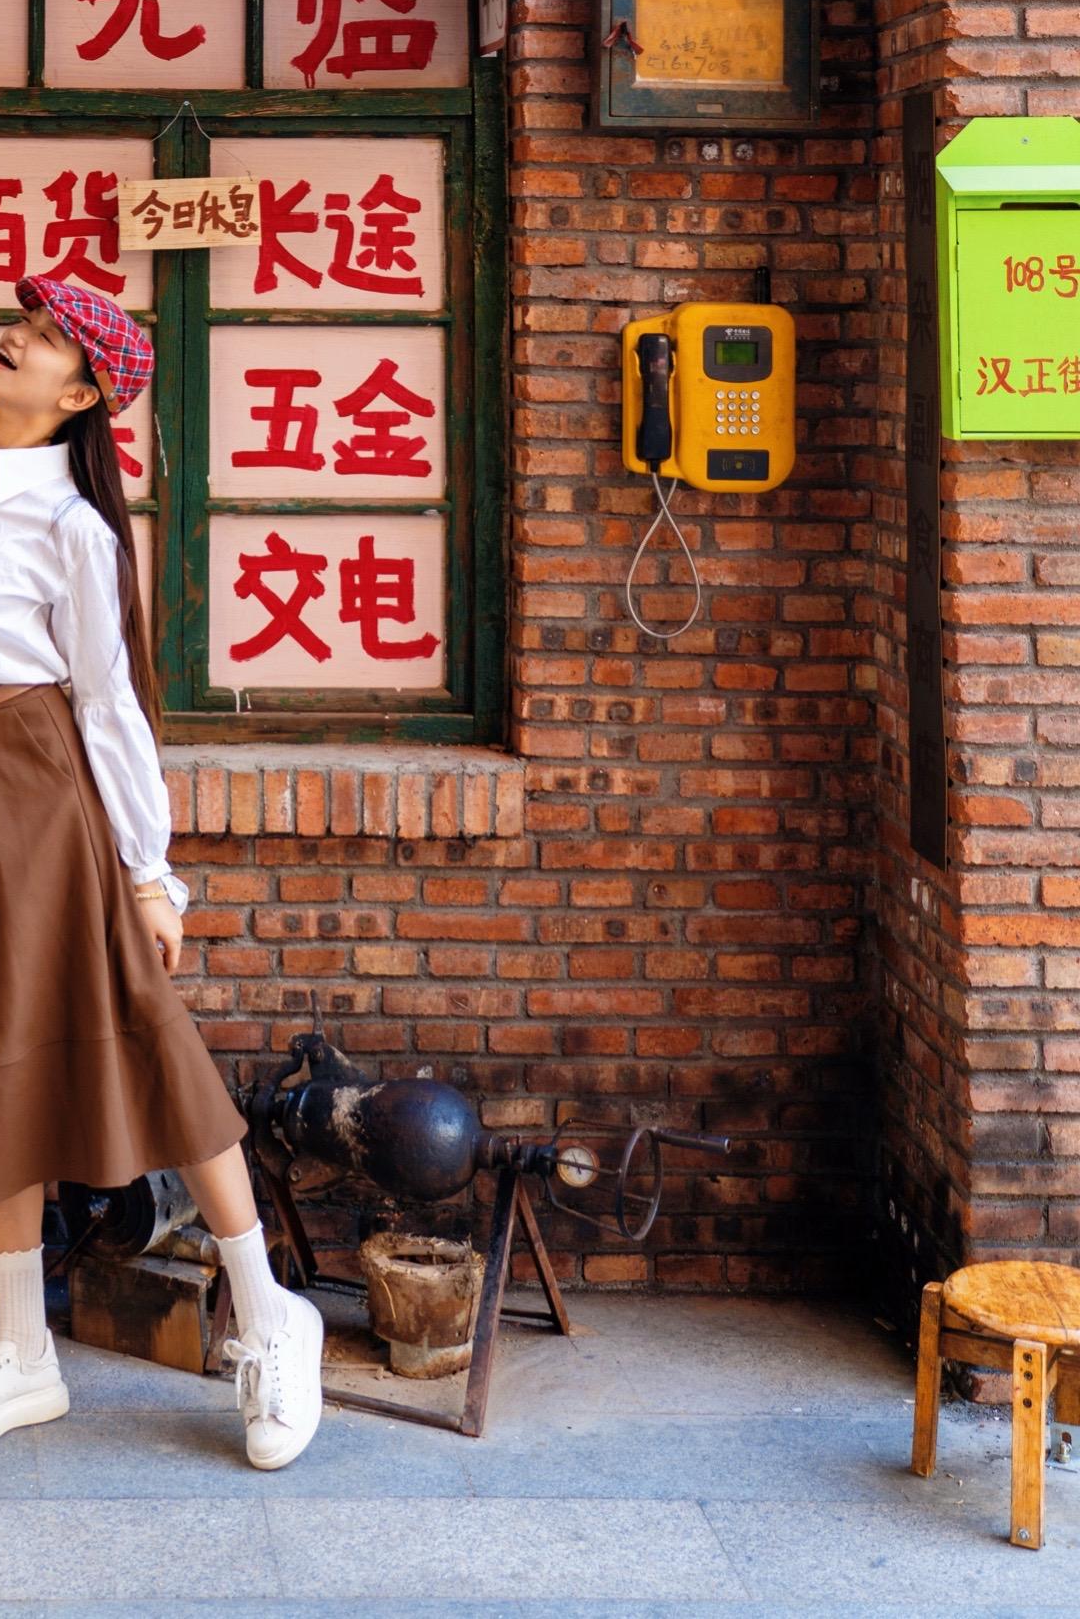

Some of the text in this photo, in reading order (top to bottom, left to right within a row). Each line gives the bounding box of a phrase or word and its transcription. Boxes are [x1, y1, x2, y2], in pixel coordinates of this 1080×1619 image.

[130, 184, 259, 241] 今日休息
[255, 173, 425, 298] 长途
[1003, 254, 1080, 299] 108号
[231, 357, 436, 478] 五金
[230, 531, 442, 664] 交电
